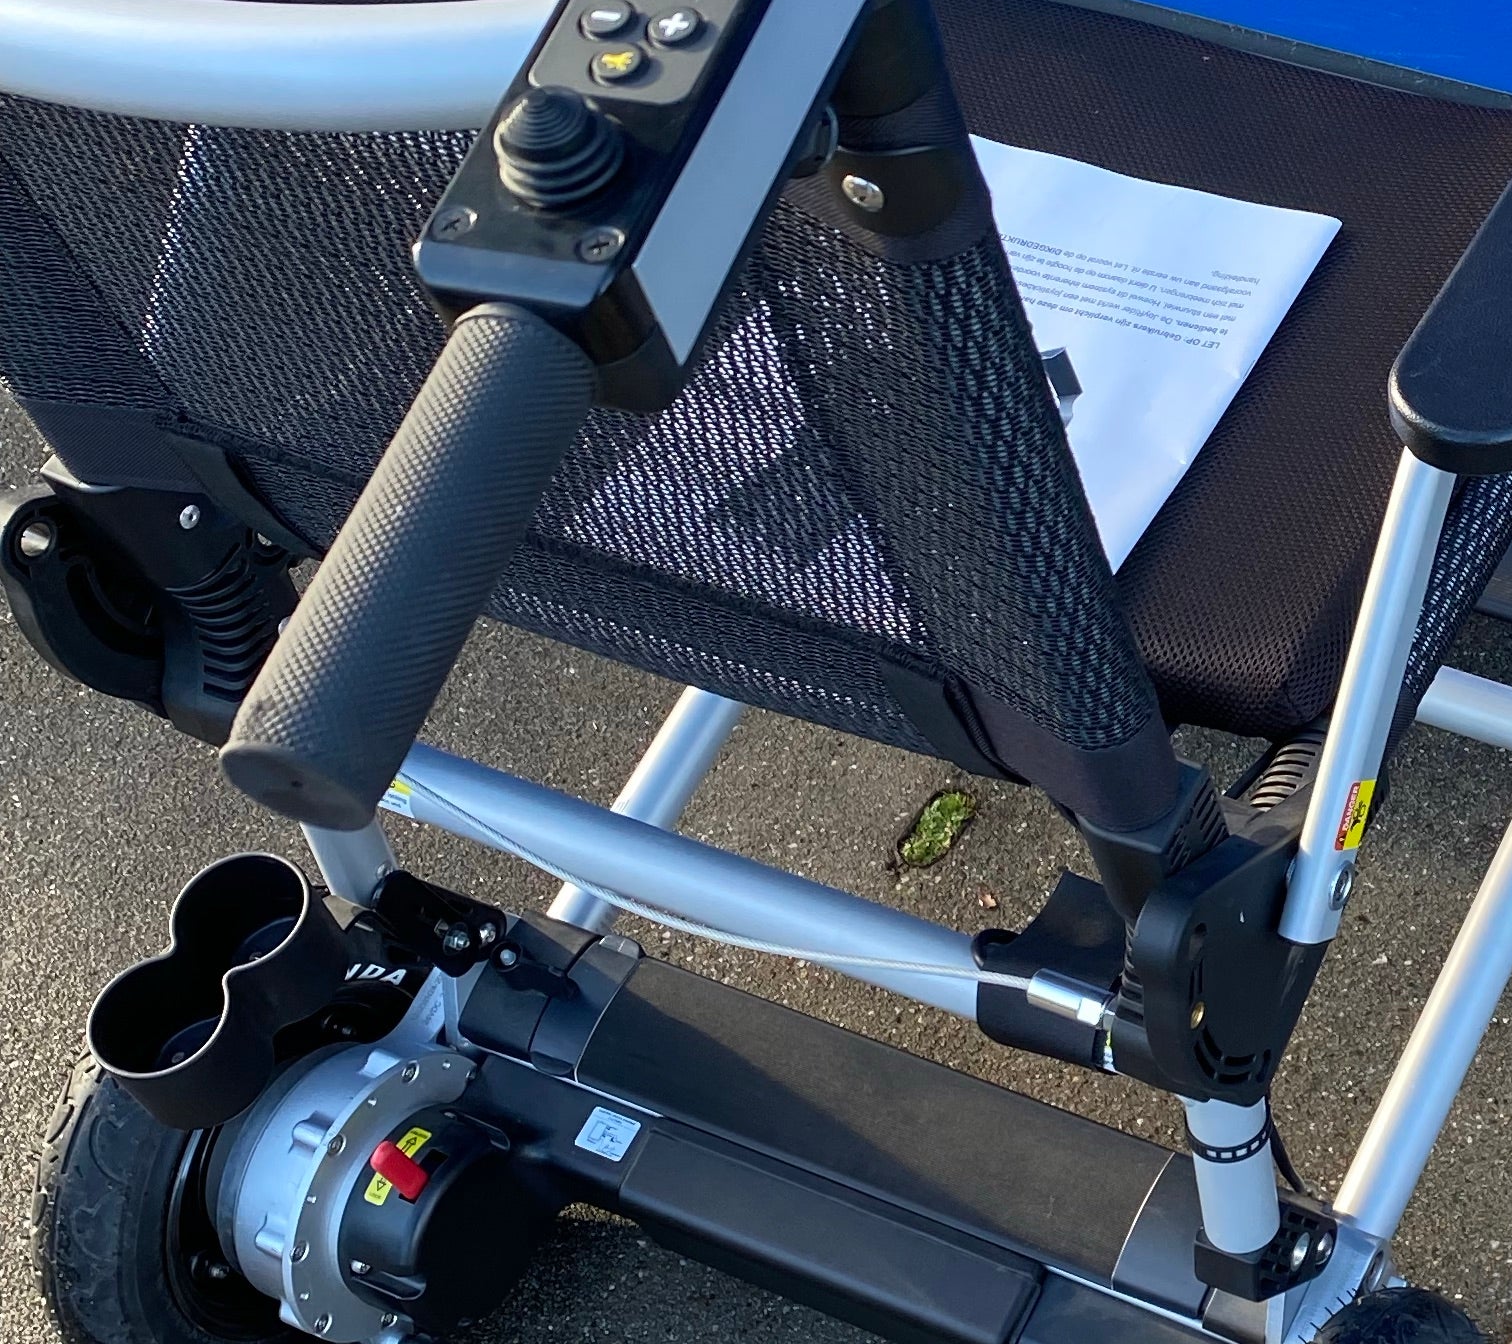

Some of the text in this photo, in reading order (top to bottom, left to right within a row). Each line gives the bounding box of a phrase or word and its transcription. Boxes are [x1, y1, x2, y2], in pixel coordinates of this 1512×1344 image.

[1133, 324, 1181, 341] Gebruikers
[1201, 340, 1220, 349] LET
[1342, 785, 1360, 833] DANGER
